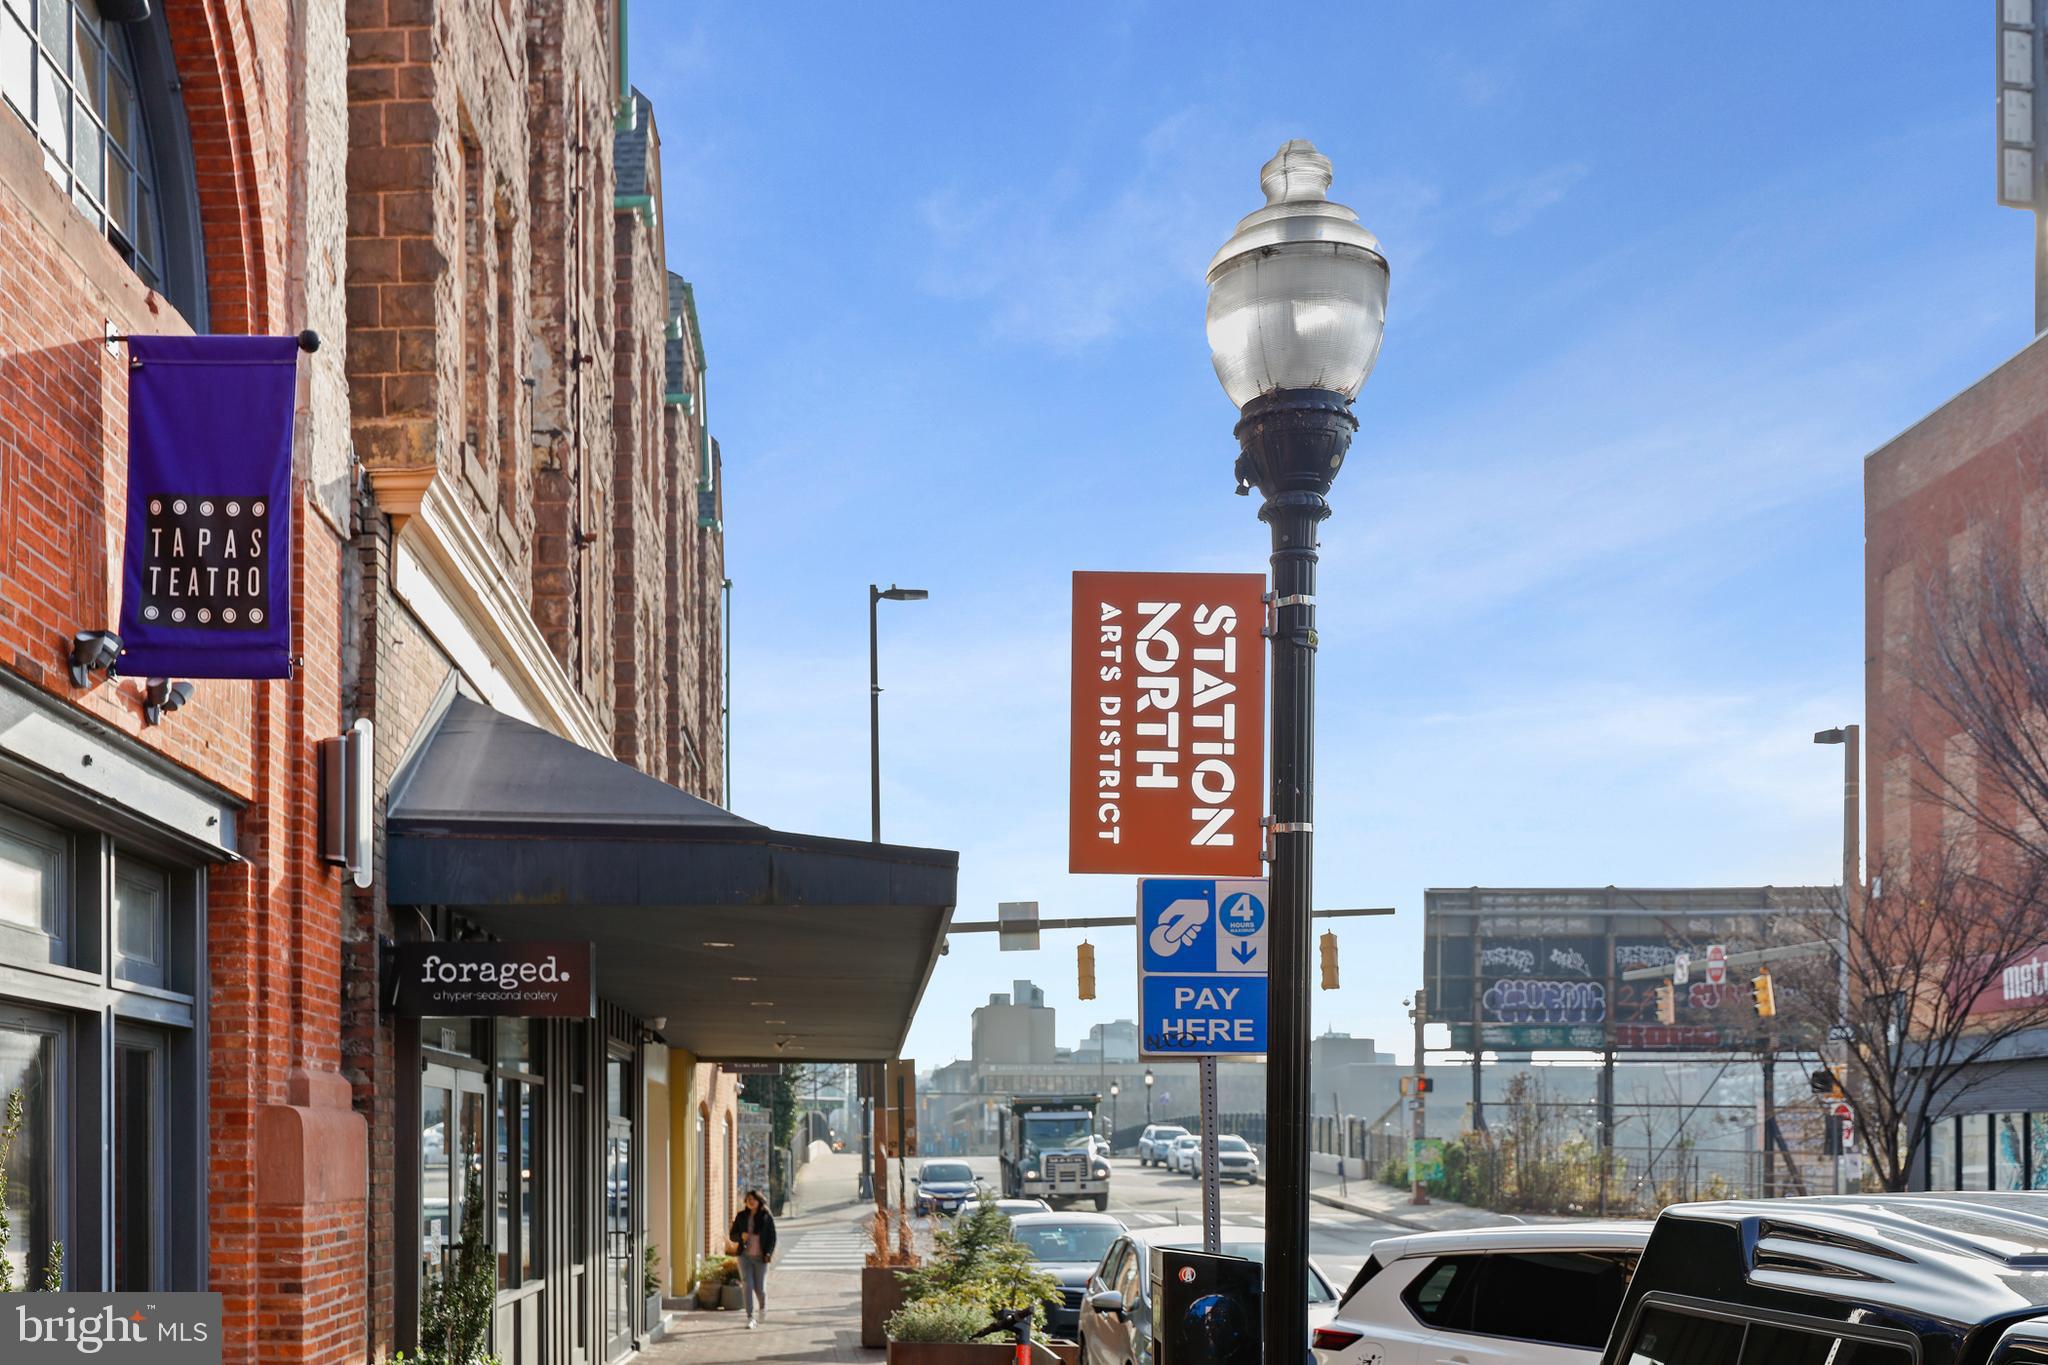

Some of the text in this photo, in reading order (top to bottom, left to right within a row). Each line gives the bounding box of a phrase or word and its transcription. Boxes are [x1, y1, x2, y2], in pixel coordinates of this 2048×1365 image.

[151, 527, 262, 558] TAPAS
[149, 566, 260, 597] TEATRO
[1135, 602, 1181, 788] NORTH
[1098, 602, 1122, 844] ARTS DISTRICT
[1230, 894, 1253, 921] 4
[421, 955, 570, 989] foraged.
[443, 990, 522, 1001] hyper-seasonal
[523, 991, 558, 1002] eatery
[1174, 987, 1240, 1010] PAY
[1162, 1018, 1254, 1041] HERE
